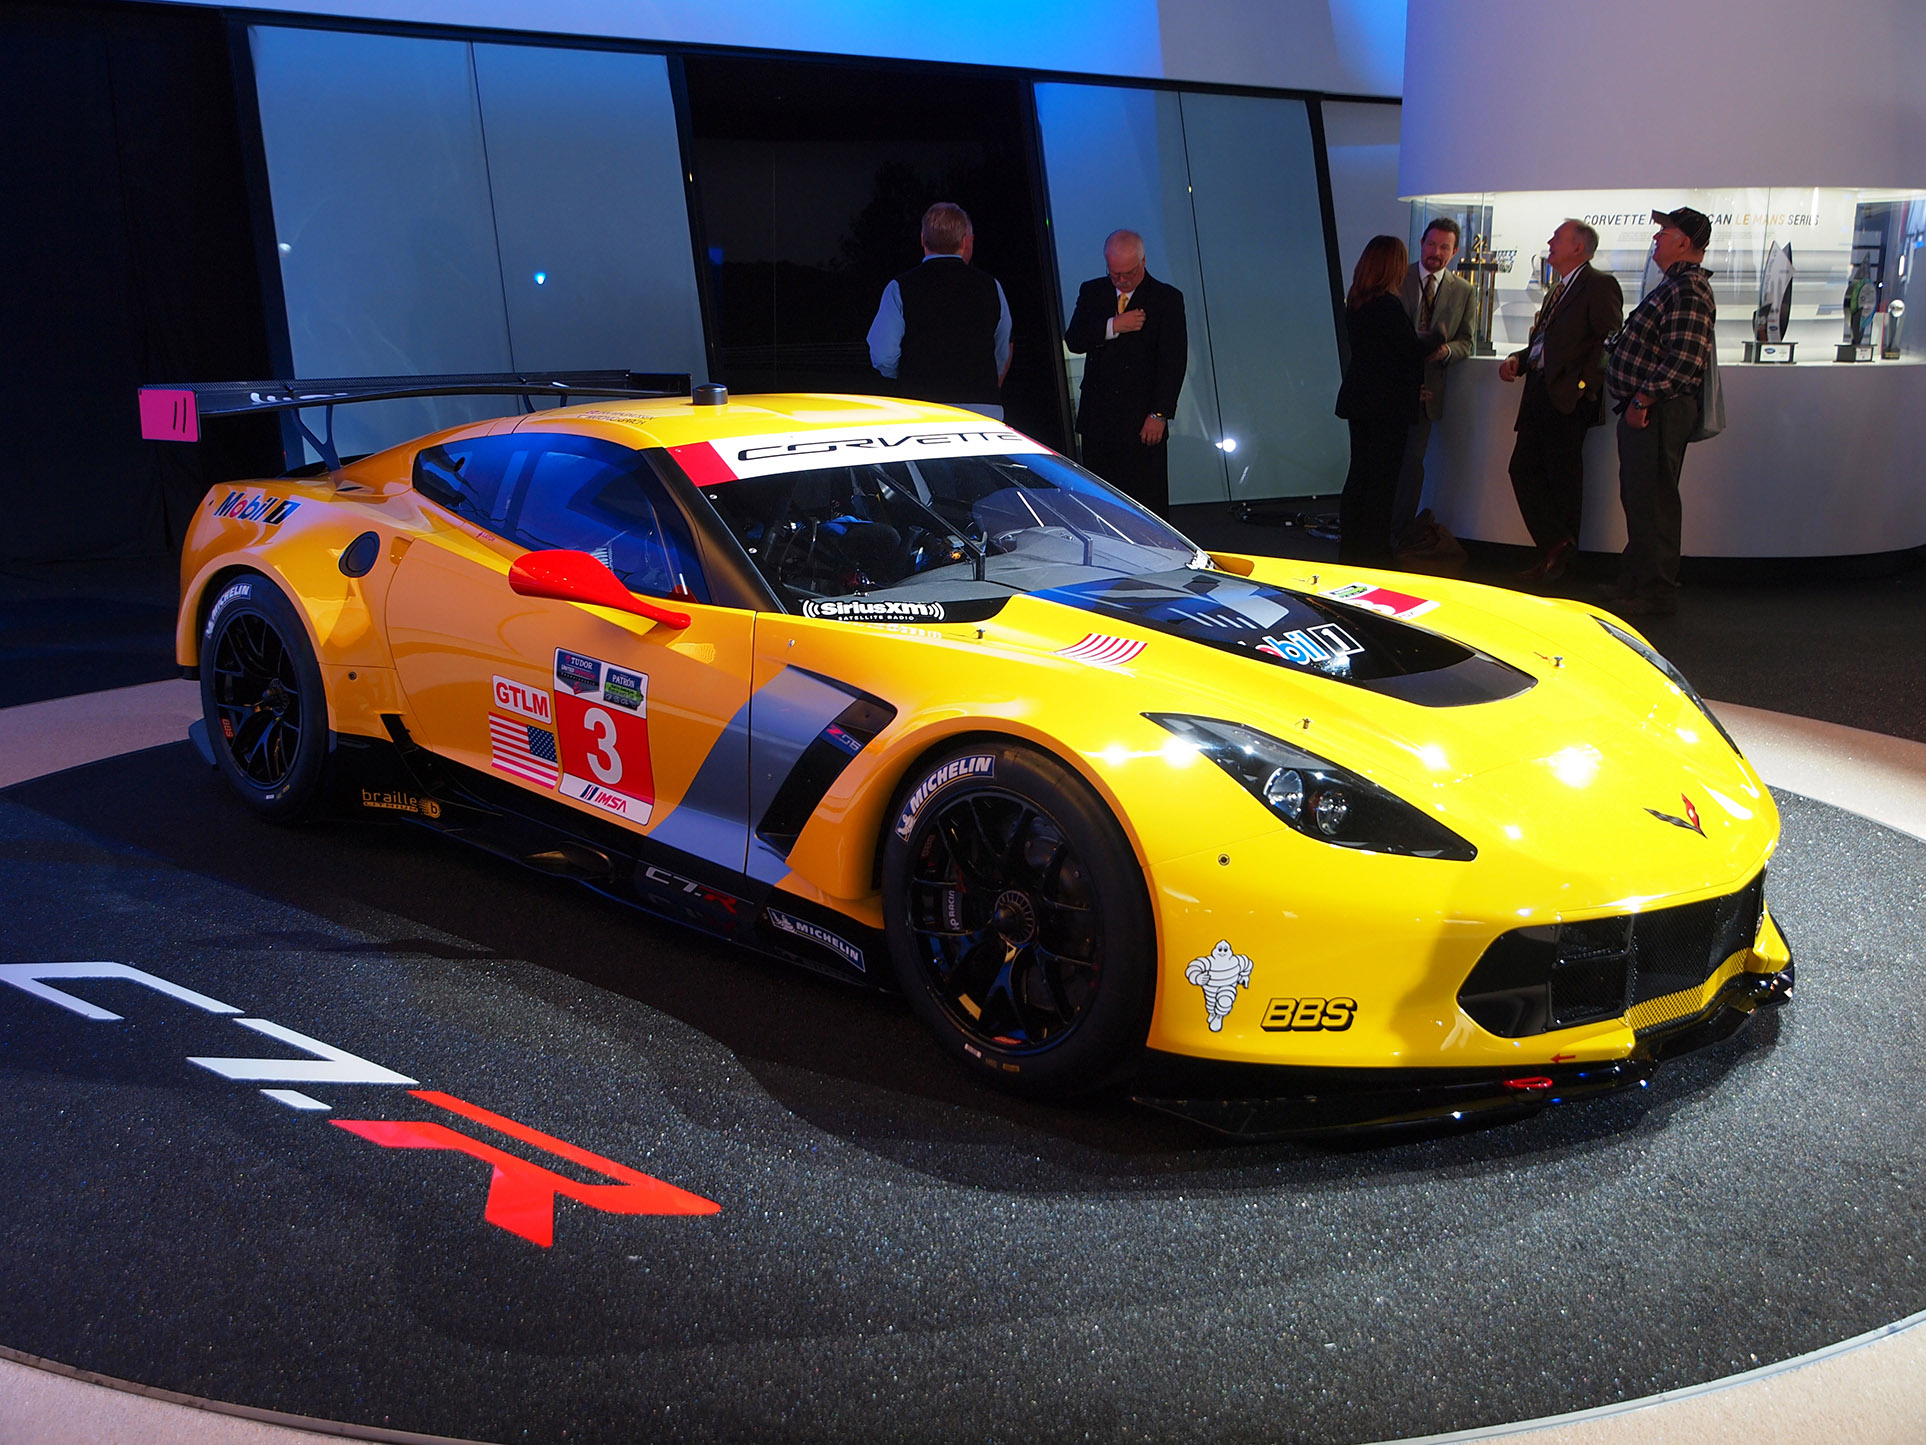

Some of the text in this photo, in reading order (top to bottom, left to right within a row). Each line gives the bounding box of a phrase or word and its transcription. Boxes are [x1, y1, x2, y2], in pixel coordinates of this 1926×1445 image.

[1584, 214, 1646, 226] CORVETTE
[1735, 213, 1751, 225] LE
[1753, 213, 1785, 225] MANS
[737, 431, 1022, 461] CORVETTE
[213, 491, 279, 521] Mobil
[211, 584, 250, 618] MICHELIN
[571, 656, 593, 670] TUDOR
[612, 674, 636, 688] PATRÓN
[496, 682, 549, 718] GTLM
[584, 707, 623, 785] 3
[826, 724, 861, 751] Z06
[362, 788, 418, 807] braille
[909, 757, 992, 814] MICHELIN
[595, 792, 628, 813] IMSA
[645, 866, 738, 915] C7.R
[796, 922, 858, 961] MICHELIN
[1260, 997, 1358, 1032] BBS
